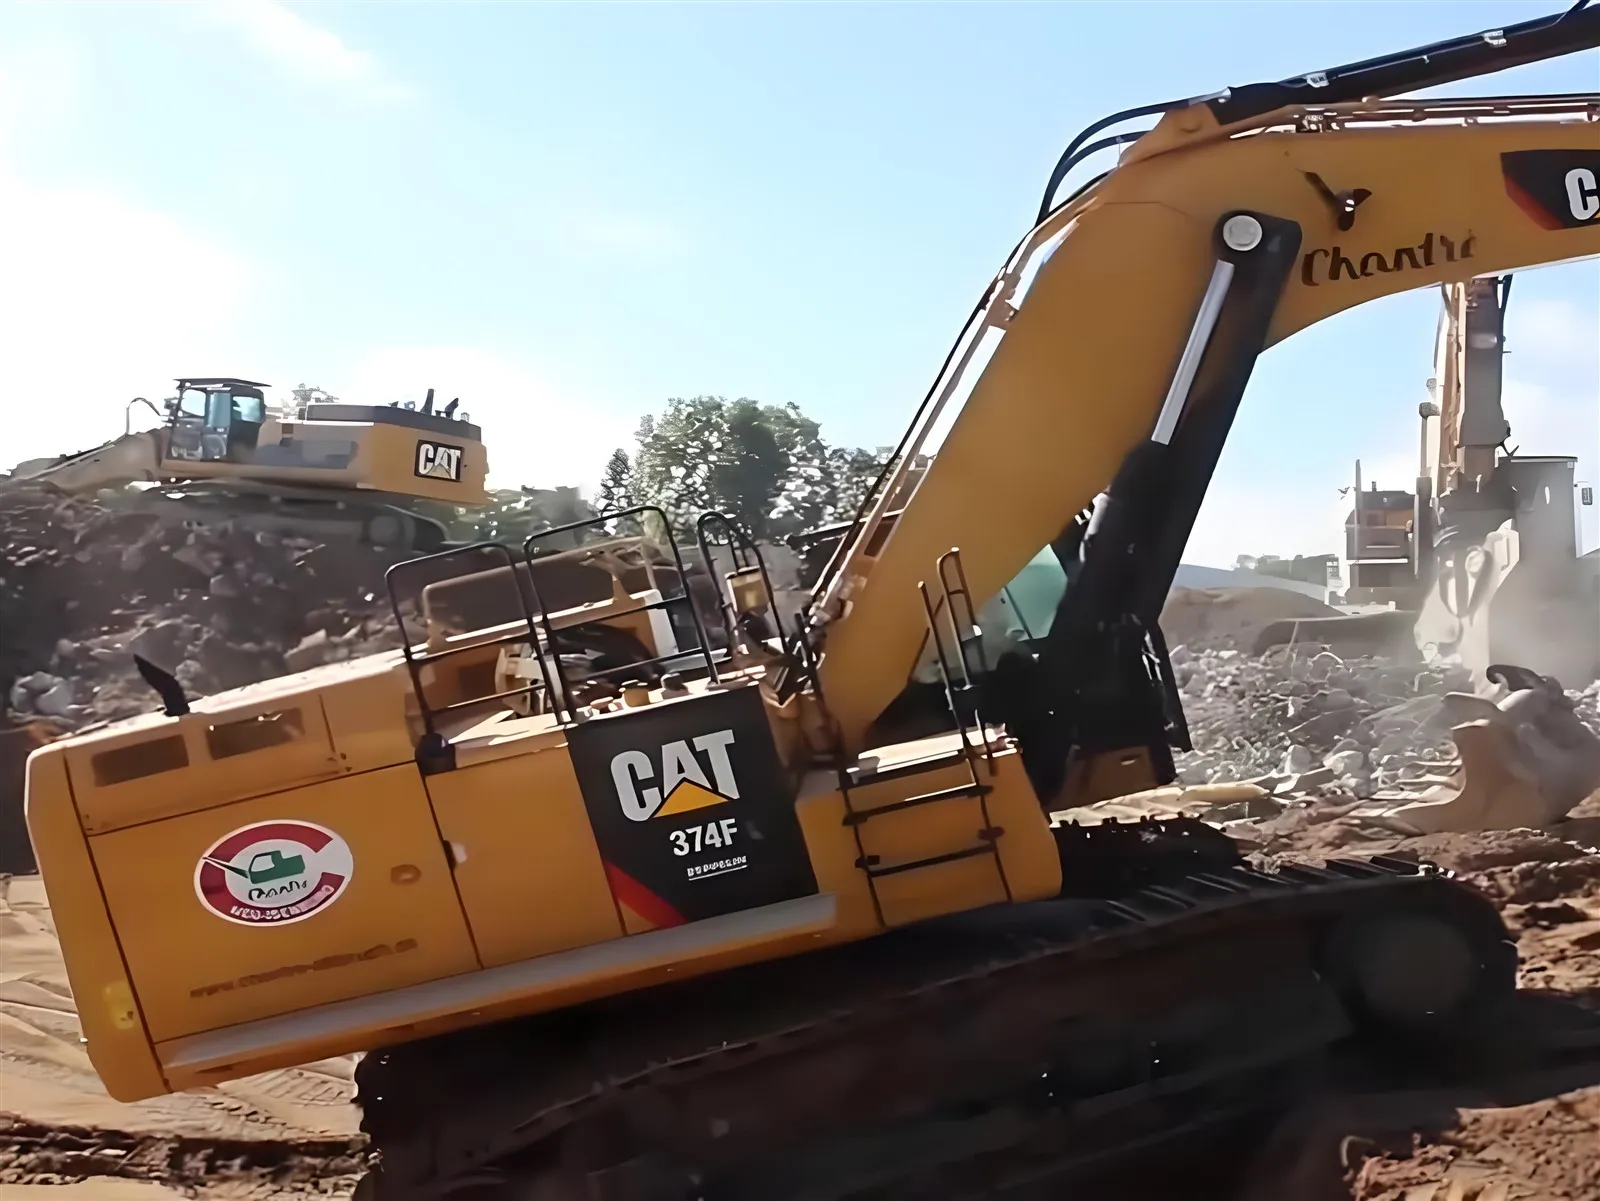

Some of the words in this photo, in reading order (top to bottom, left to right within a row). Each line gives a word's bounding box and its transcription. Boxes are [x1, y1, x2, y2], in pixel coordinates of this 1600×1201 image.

[419, 443, 461, 480] CAT
[610, 729, 740, 822] CAT
[669, 818, 738, 857] 374F
